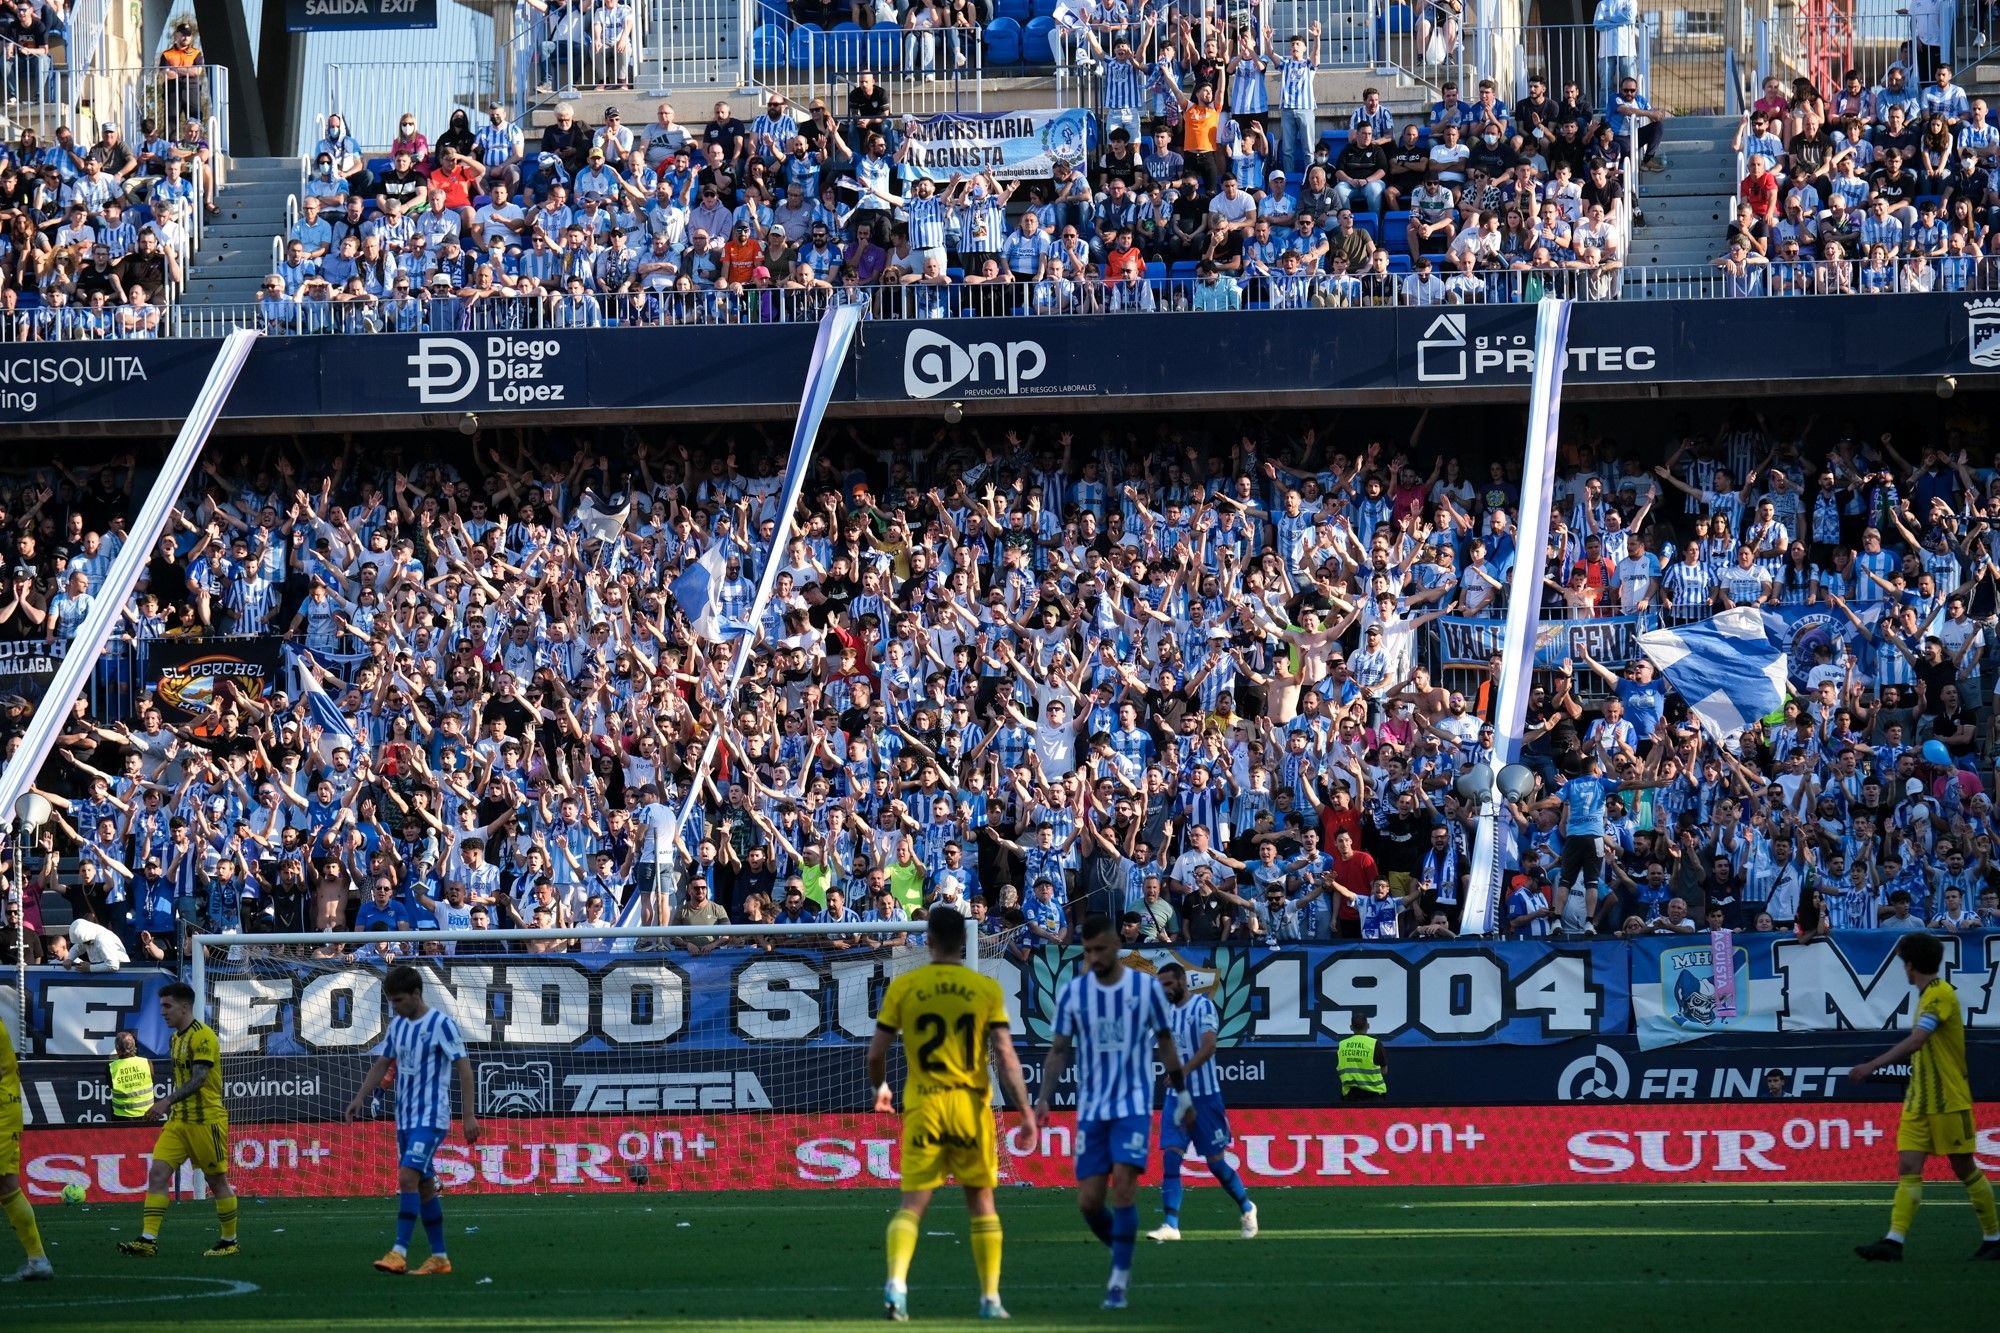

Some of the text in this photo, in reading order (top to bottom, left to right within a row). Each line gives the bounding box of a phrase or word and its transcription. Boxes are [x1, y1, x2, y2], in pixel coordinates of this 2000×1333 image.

[305, 0, 417, 15] SALIDA EXIT
[487, 336, 560, 361] Diego
[488, 358, 543, 380] Díaz
[1475, 346, 1656, 374] PRTEC
[488, 381, 565, 404] López
[964, 387, 1007, 396] PREVENCIÓN
[1030, 385, 1057, 393] RIESGOS
[1059, 383, 1096, 392] LABORALES
[0, 657, 54, 676] MÁLAGA
[162, 662, 265, 679] EL PERCHEL
[1254, 956, 1597, 1036] 1904
[915, 1012, 977, 1072] 21
[1342, 1049, 1370, 1057] SECURITY
[117, 1072, 146, 1084] SECURITY
[120, 1066, 139, 1075] ROYAL
[1384, 1121, 1486, 1154] on+
[1566, 1117, 1884, 1175] SUR on+
